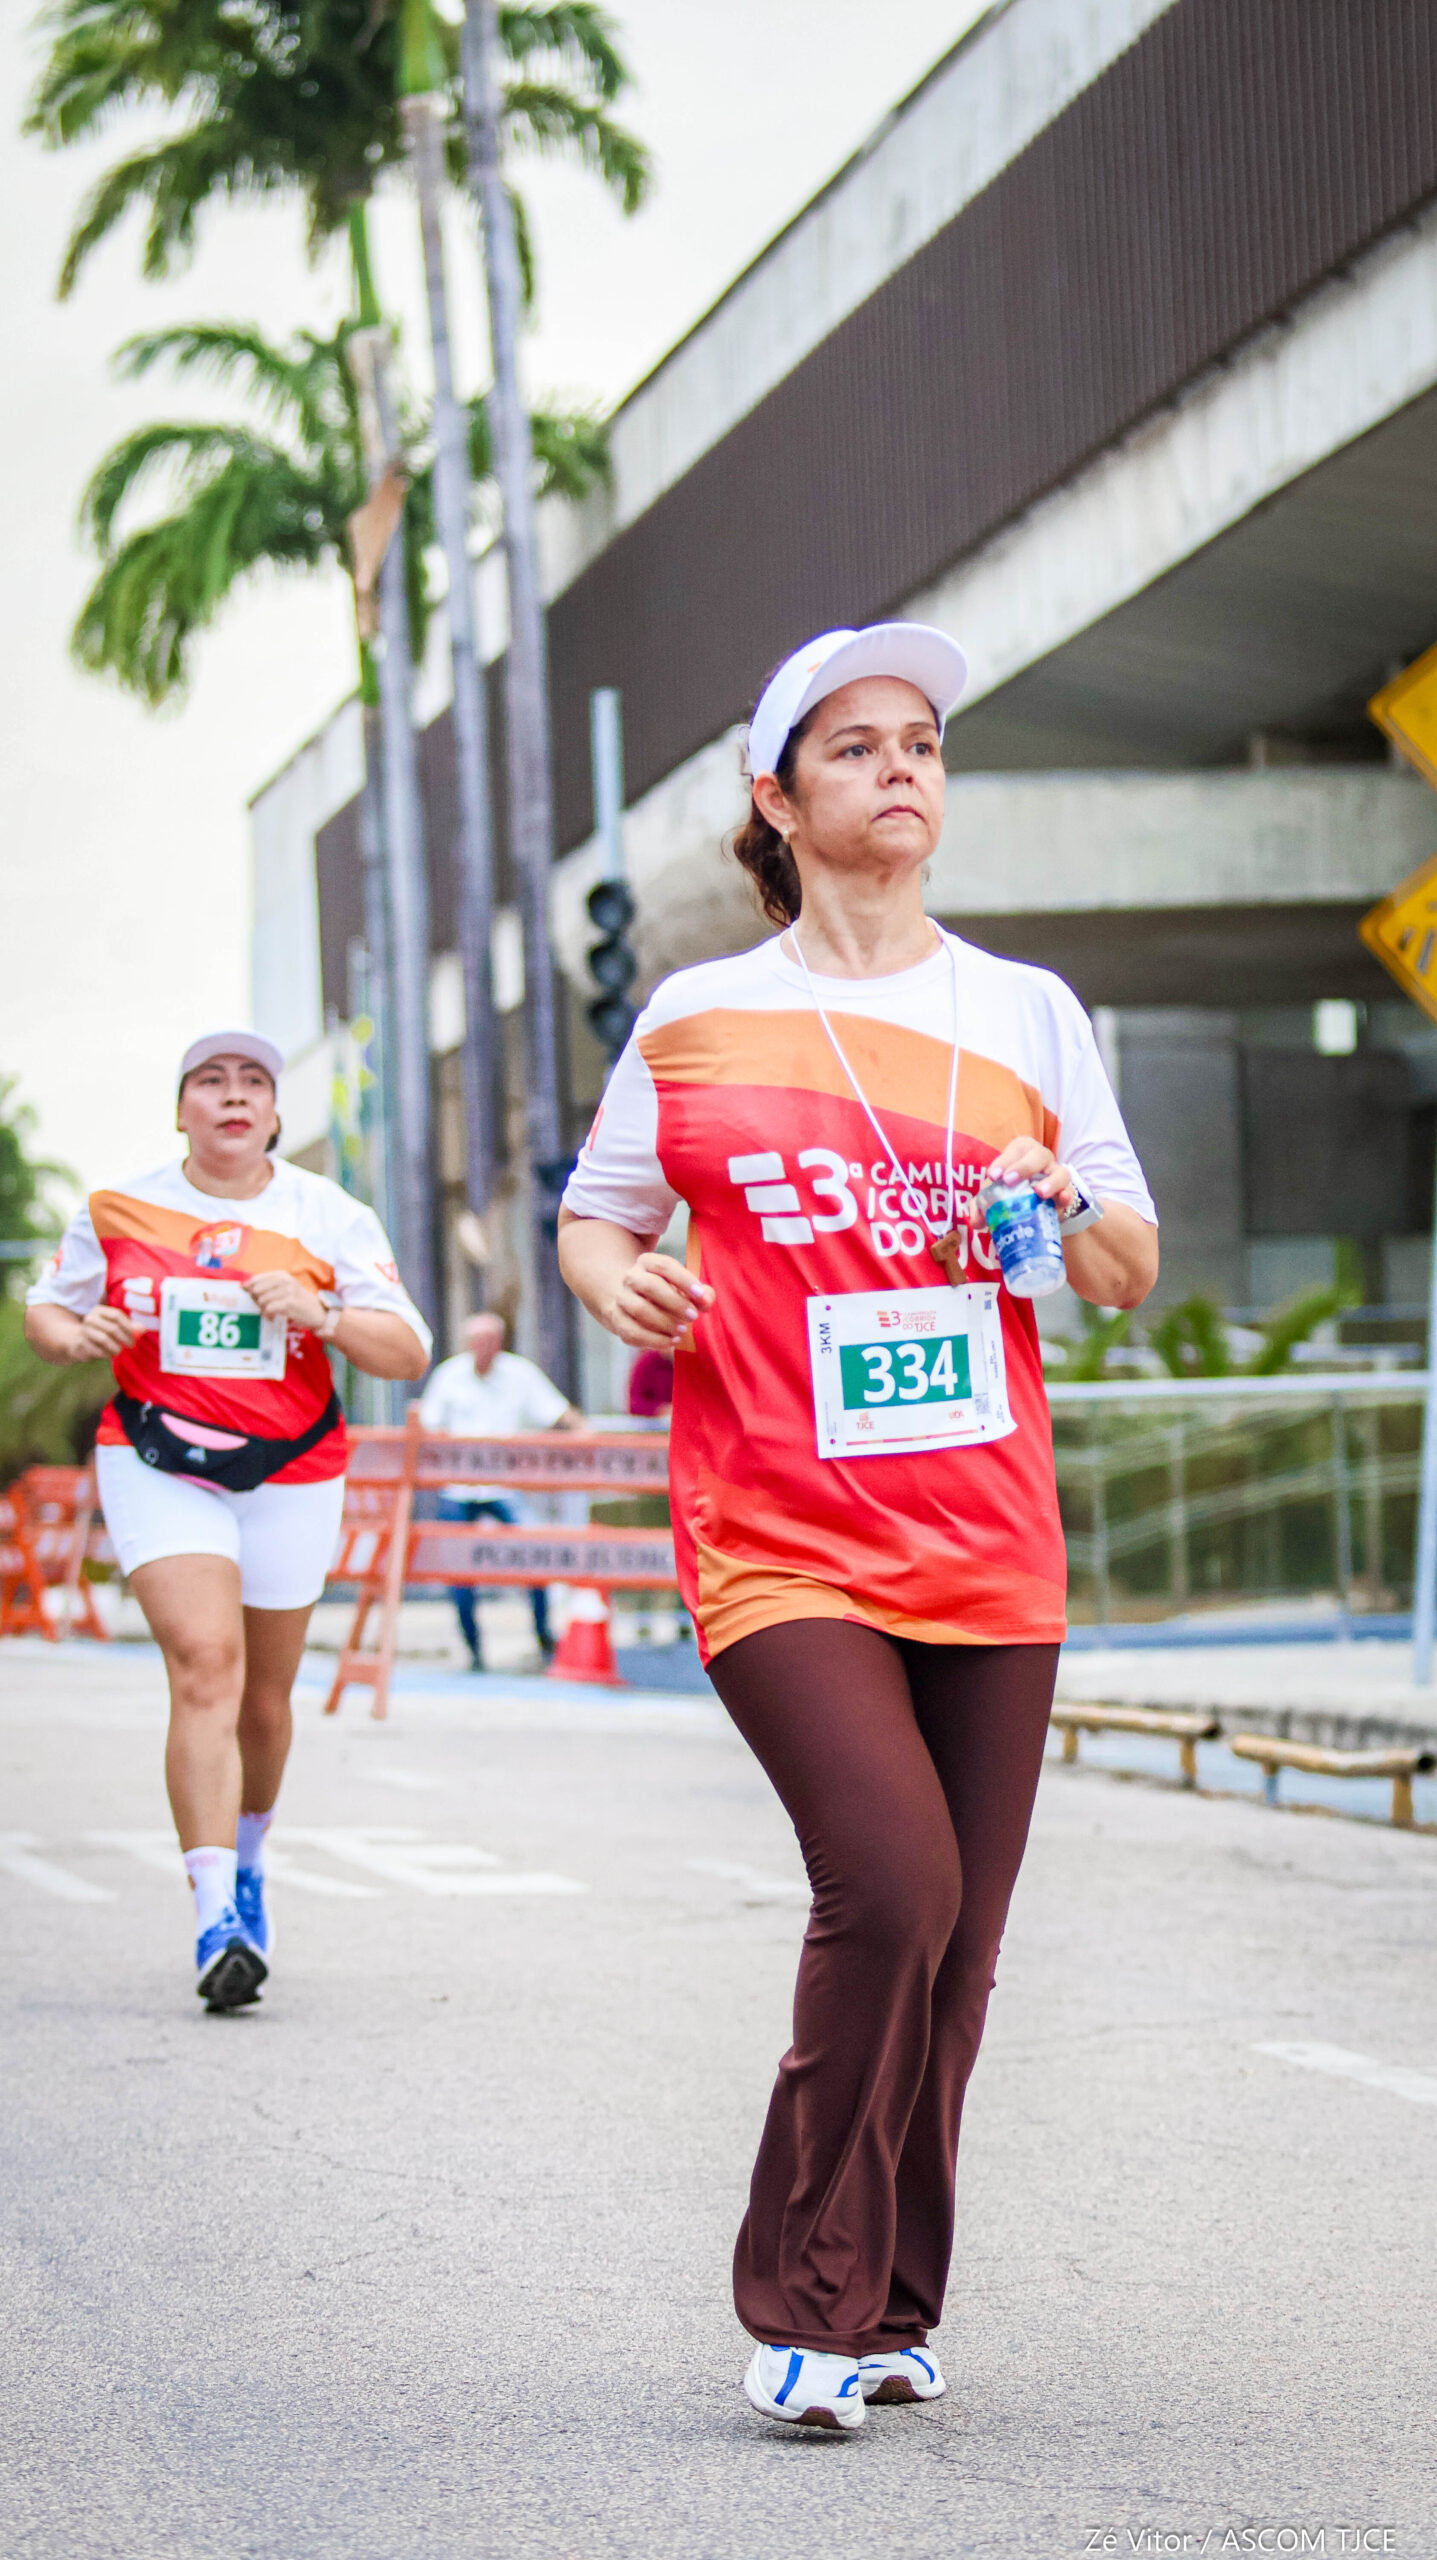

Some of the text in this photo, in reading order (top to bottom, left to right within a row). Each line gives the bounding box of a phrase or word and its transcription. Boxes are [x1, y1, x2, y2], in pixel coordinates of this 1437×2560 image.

[870, 1161, 988, 1187] CAMINH
[869, 1220, 925, 1257] DO
[199, 1312, 241, 1348] 86
[819, 1322, 832, 1354] 3KM
[914, 1321, 936, 1332] TJCE
[861, 1340, 958, 1403] 334
